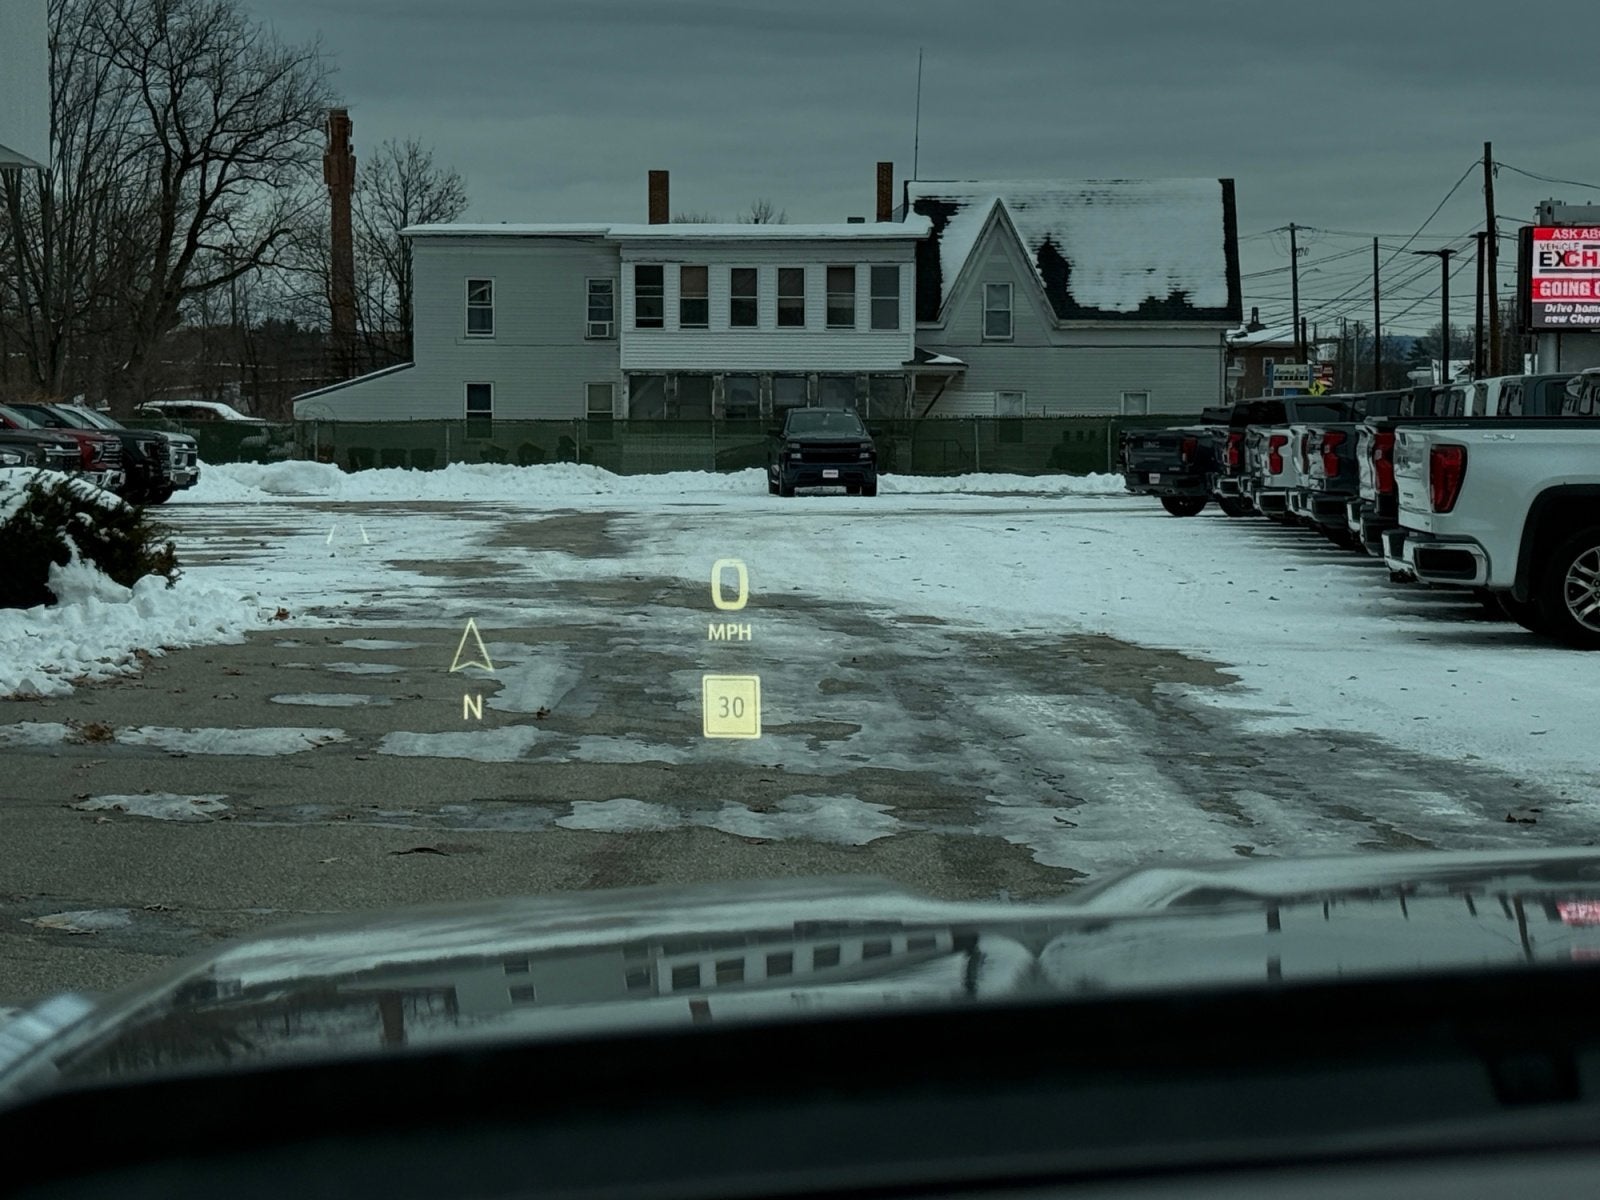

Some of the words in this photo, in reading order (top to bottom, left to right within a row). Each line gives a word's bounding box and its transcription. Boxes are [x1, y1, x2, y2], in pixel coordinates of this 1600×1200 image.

[1551, 229, 1578, 239] ASK
[1581, 229, 1600, 239] AB
[1539, 251, 1600, 267] EXCH
[1539, 281, 1591, 296] GOING
[1544, 303, 1573, 313] Drive
[1544, 315, 1568, 323] new
[711, 558, 749, 610] 0
[708, 623, 752, 641] MPH
[463, 694, 482, 720] N
[718, 696, 745, 718] 30
